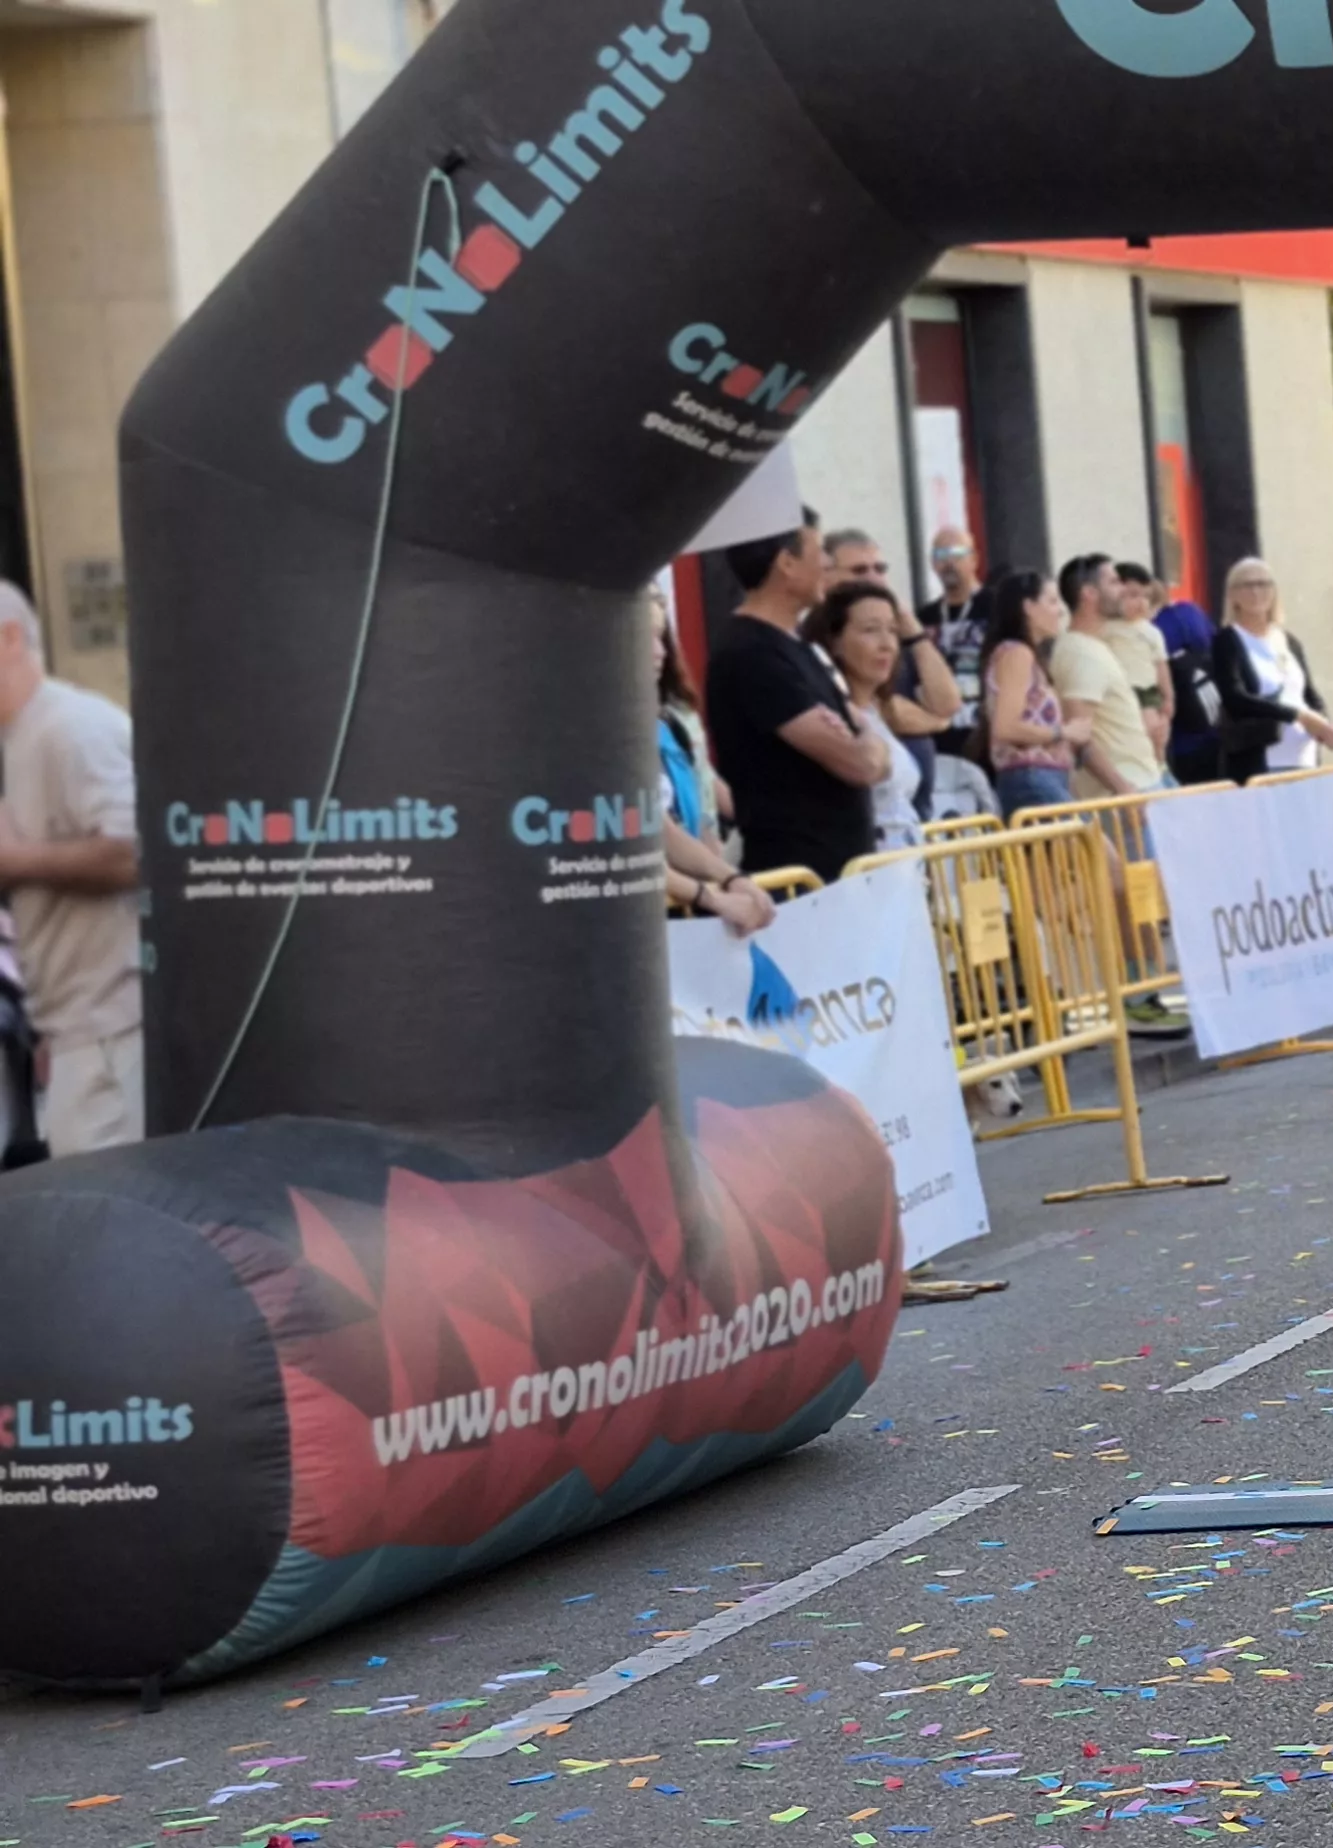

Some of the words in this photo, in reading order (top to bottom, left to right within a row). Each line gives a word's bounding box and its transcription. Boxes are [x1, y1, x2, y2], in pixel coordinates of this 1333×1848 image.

[245, 857, 266, 873] de
[236, 879, 255, 897] de
[331, 876, 433, 896] deportivos
[373, 1259, 885, 1467] www.cronolimits2020.com
[10, 1462, 90, 1481] imagen
[93, 1461, 109, 1480] y
[51, 1482, 158, 1506] deportivo
